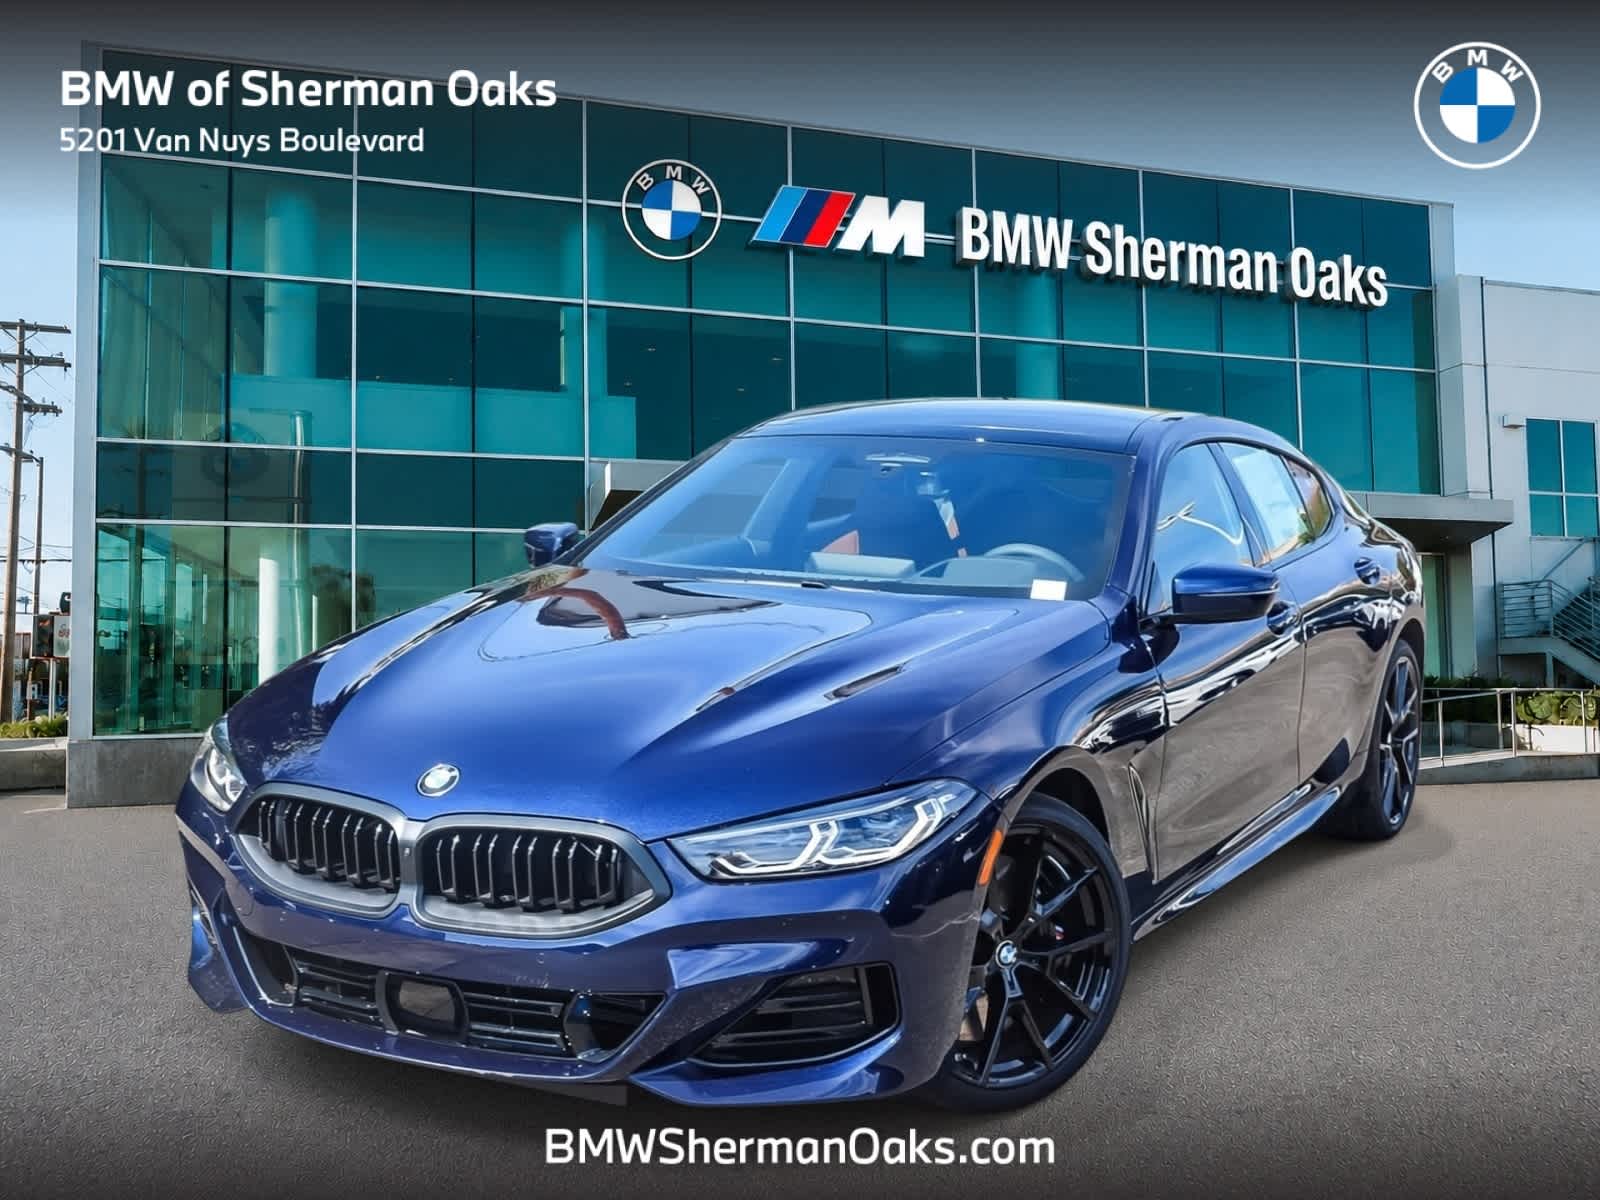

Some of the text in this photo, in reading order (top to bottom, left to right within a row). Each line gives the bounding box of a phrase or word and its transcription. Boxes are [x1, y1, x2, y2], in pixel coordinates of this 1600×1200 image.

[636, 165, 711, 196] BMW
[959, 206, 1388, 308] BMW Sherman Oaks
